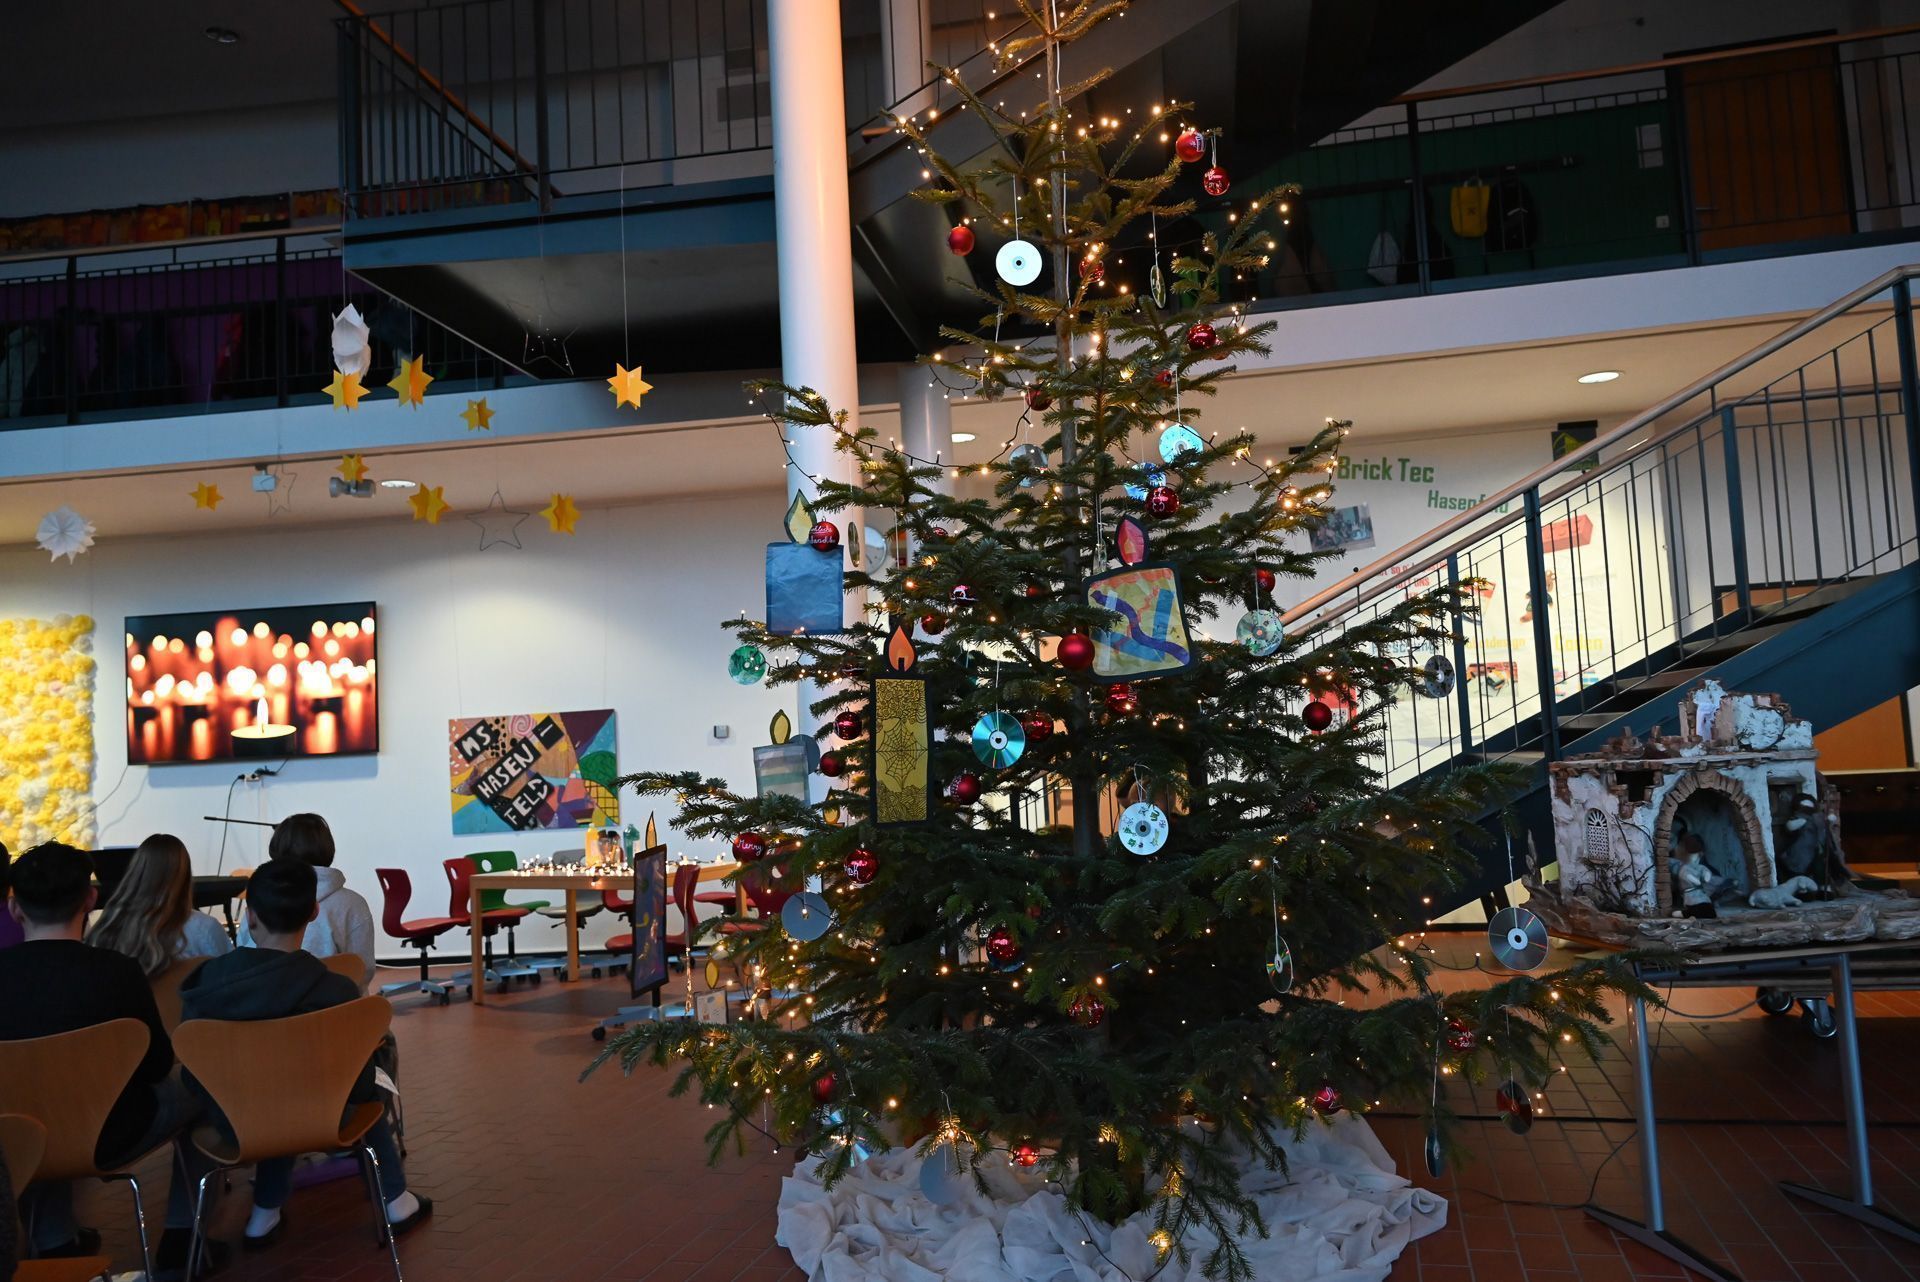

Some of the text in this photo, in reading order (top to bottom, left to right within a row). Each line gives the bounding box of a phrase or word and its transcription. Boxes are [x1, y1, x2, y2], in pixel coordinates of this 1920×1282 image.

[1338, 456, 1434, 483] Brick Tec
[462, 725, 491, 757] MS
[504, 778, 548, 825] FELD
[737, 840, 763, 856] Merry
